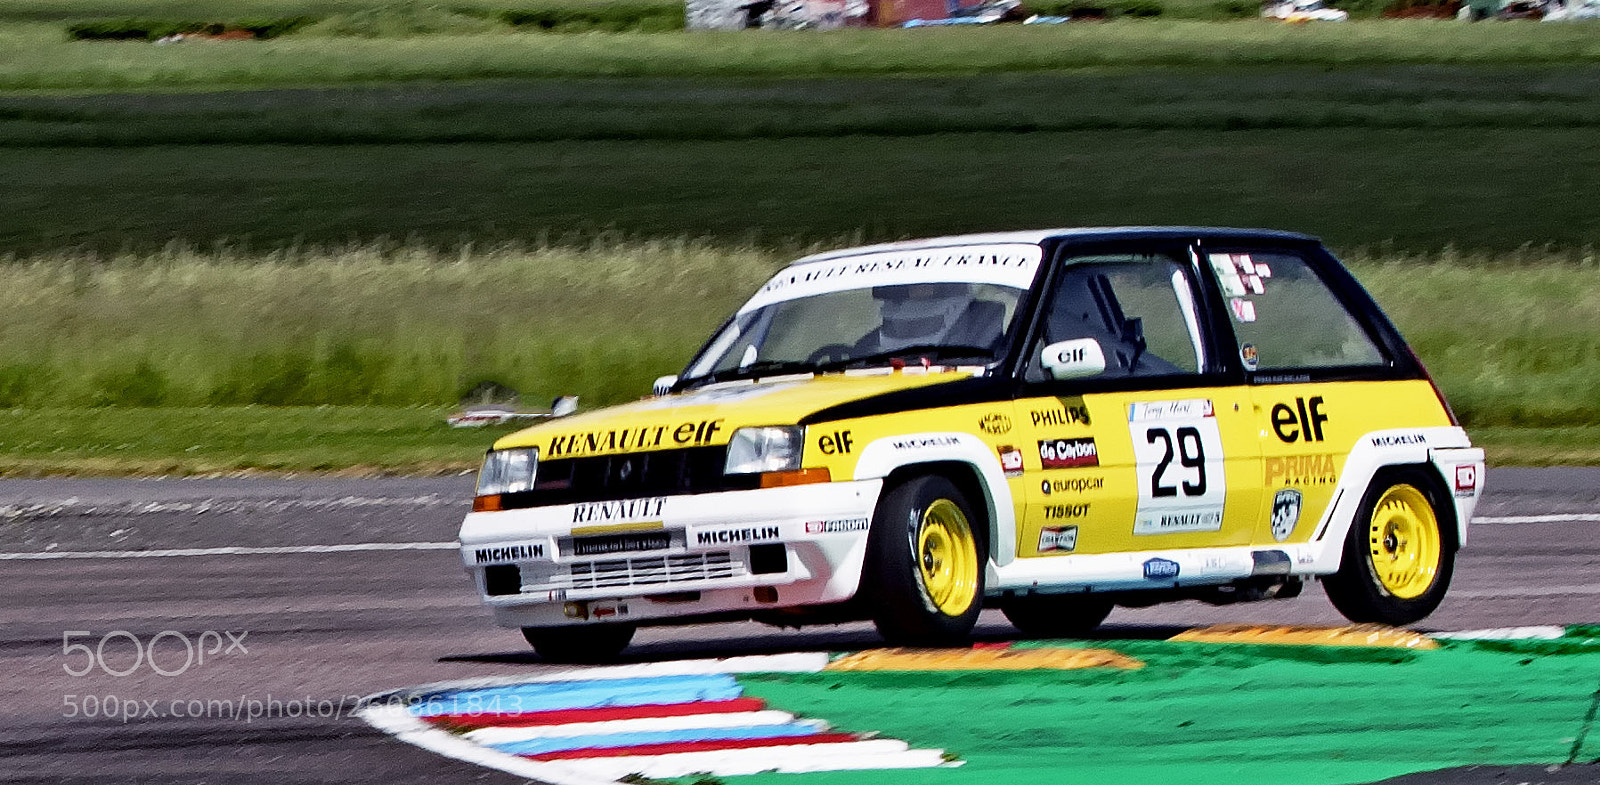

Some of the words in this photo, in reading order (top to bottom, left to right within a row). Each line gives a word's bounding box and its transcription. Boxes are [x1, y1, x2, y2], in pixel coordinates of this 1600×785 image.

[1057, 347, 1087, 363] elf
[1030, 405, 1091, 426] PHILIPS
[1271, 395, 1328, 443] elf
[548, 425, 669, 456] RENAULT
[673, 418, 725, 446] elf
[818, 430, 853, 455] elf
[893, 436, 961, 450] MICHELIN
[1371, 433, 1427, 448] MICHELIN
[1146, 427, 1206, 498] 29
[1265, 454, 1336, 488] PRIMA
[1053, 477, 1104, 494] europcar
[1285, 475, 1336, 486] RACING
[572, 497, 667, 523] RENAULT
[1044, 502, 1091, 519] TISSOT
[697, 526, 779, 544] MICHELIN
[475, 544, 543, 563] MICHELIN
